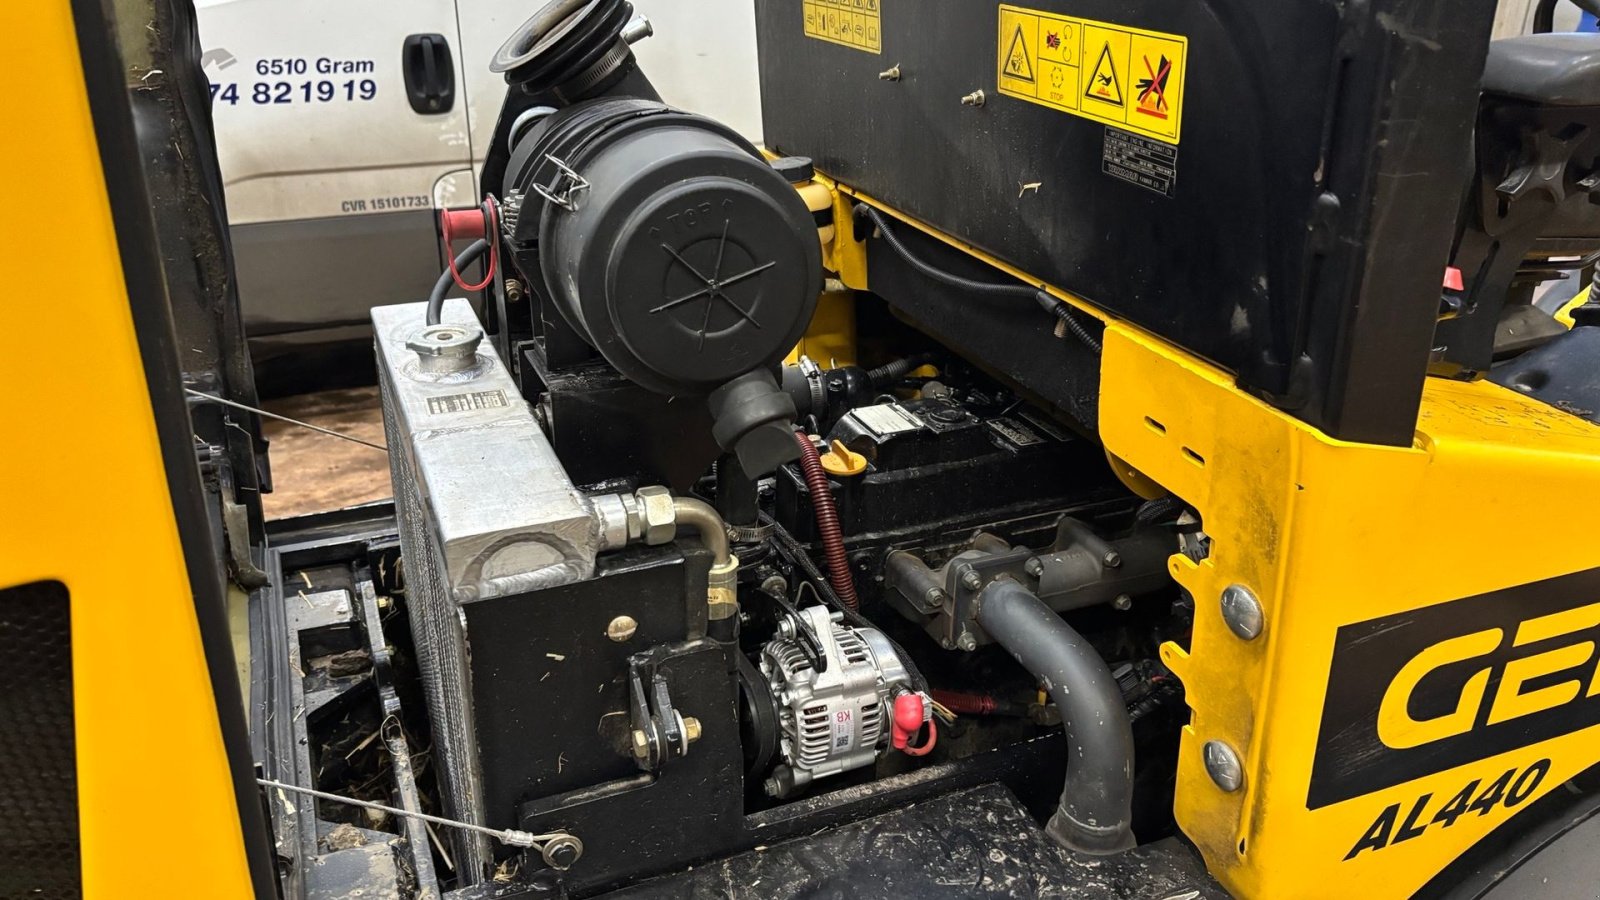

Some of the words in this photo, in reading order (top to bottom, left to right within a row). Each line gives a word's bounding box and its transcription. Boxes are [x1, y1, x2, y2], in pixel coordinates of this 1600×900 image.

[256, 58, 307, 75] 6510
[316, 57, 375, 74] Gram
[209, 83, 240, 106] 74
[252, 82, 292, 105] 82
[300, 81, 334, 103] 19
[343, 79, 377, 101] 19
[342, 200, 367, 213] CVR
[370, 195, 430, 211] 15101733
[666, 201, 712, 230] TOP
[1377, 602, 1600, 750] GE
[836, 710, 851, 723] KB
[1341, 758, 1552, 863] AL440
